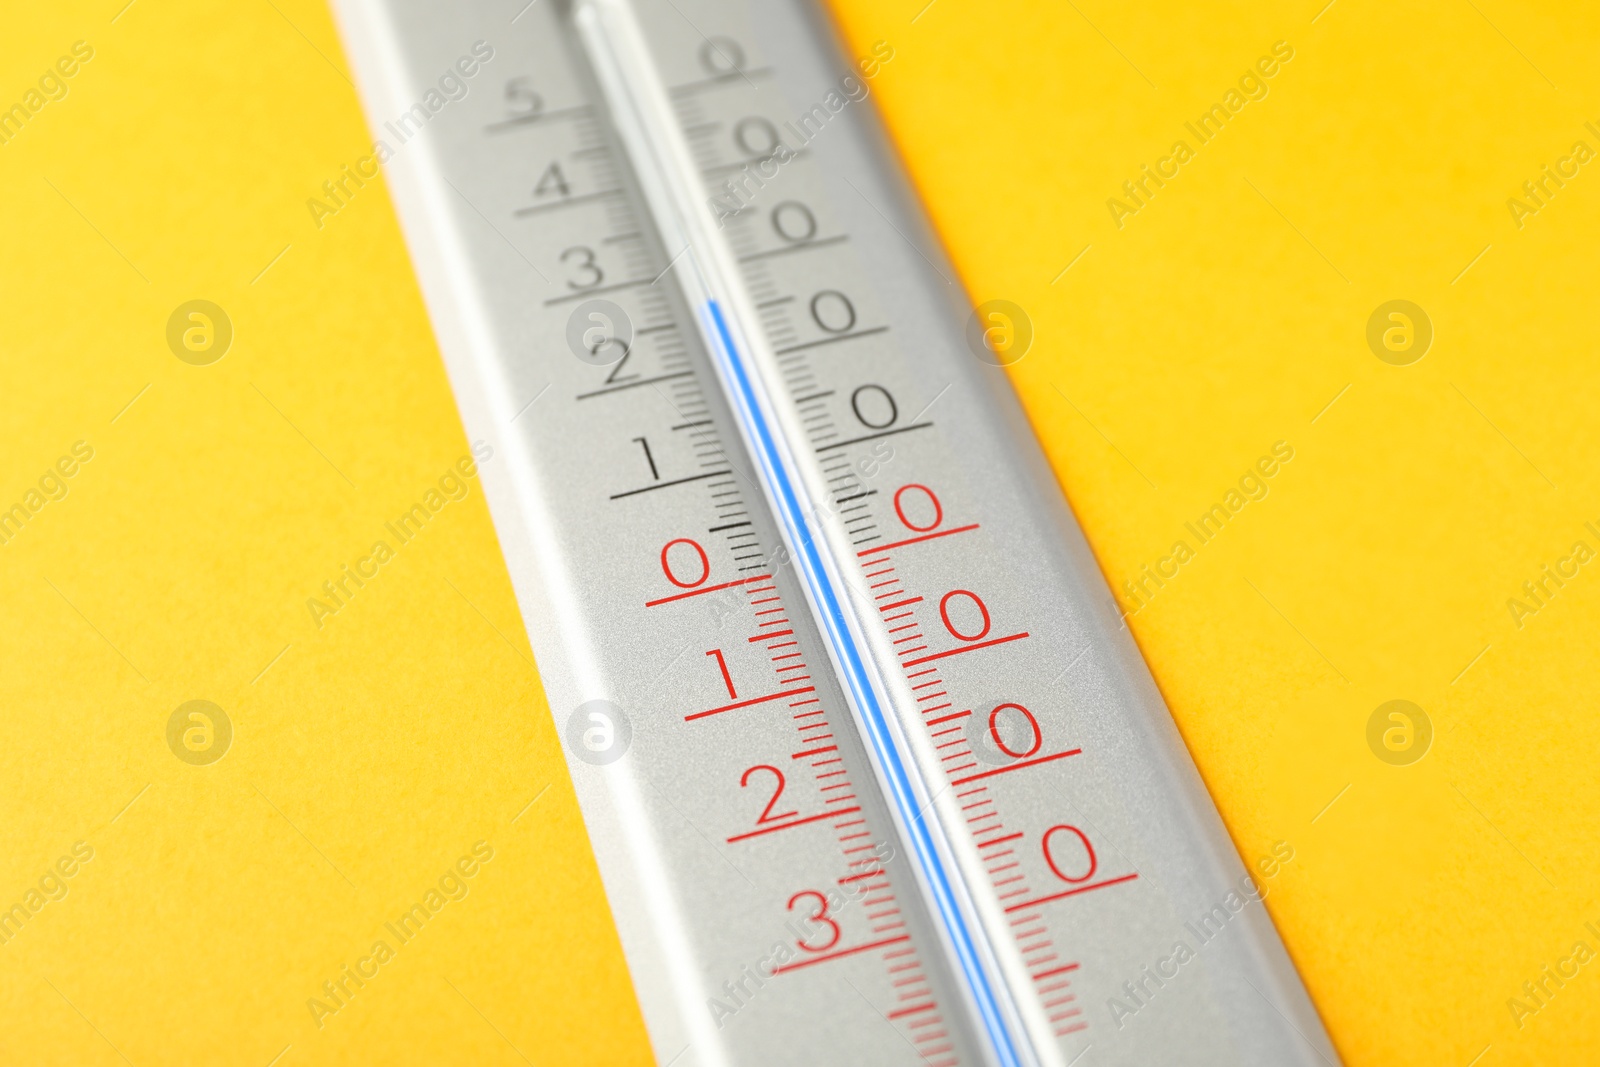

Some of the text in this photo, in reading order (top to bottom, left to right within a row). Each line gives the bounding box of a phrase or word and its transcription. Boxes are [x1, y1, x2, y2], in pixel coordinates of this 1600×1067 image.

[505, 36, 746, 117] 5 0
[533, 116, 781, 196] 4 0
[559, 201, 817, 290] 3 0
[591, 290, 856, 384] 2 0
[632, 384, 898, 480] 1 0
[894, 484, 942, 532] 0
[661, 538, 709, 588] 0
[706, 590, 990, 699] 1 0
[740, 703, 1042, 825] 2 0
[787, 825, 1097, 952] 3 0
